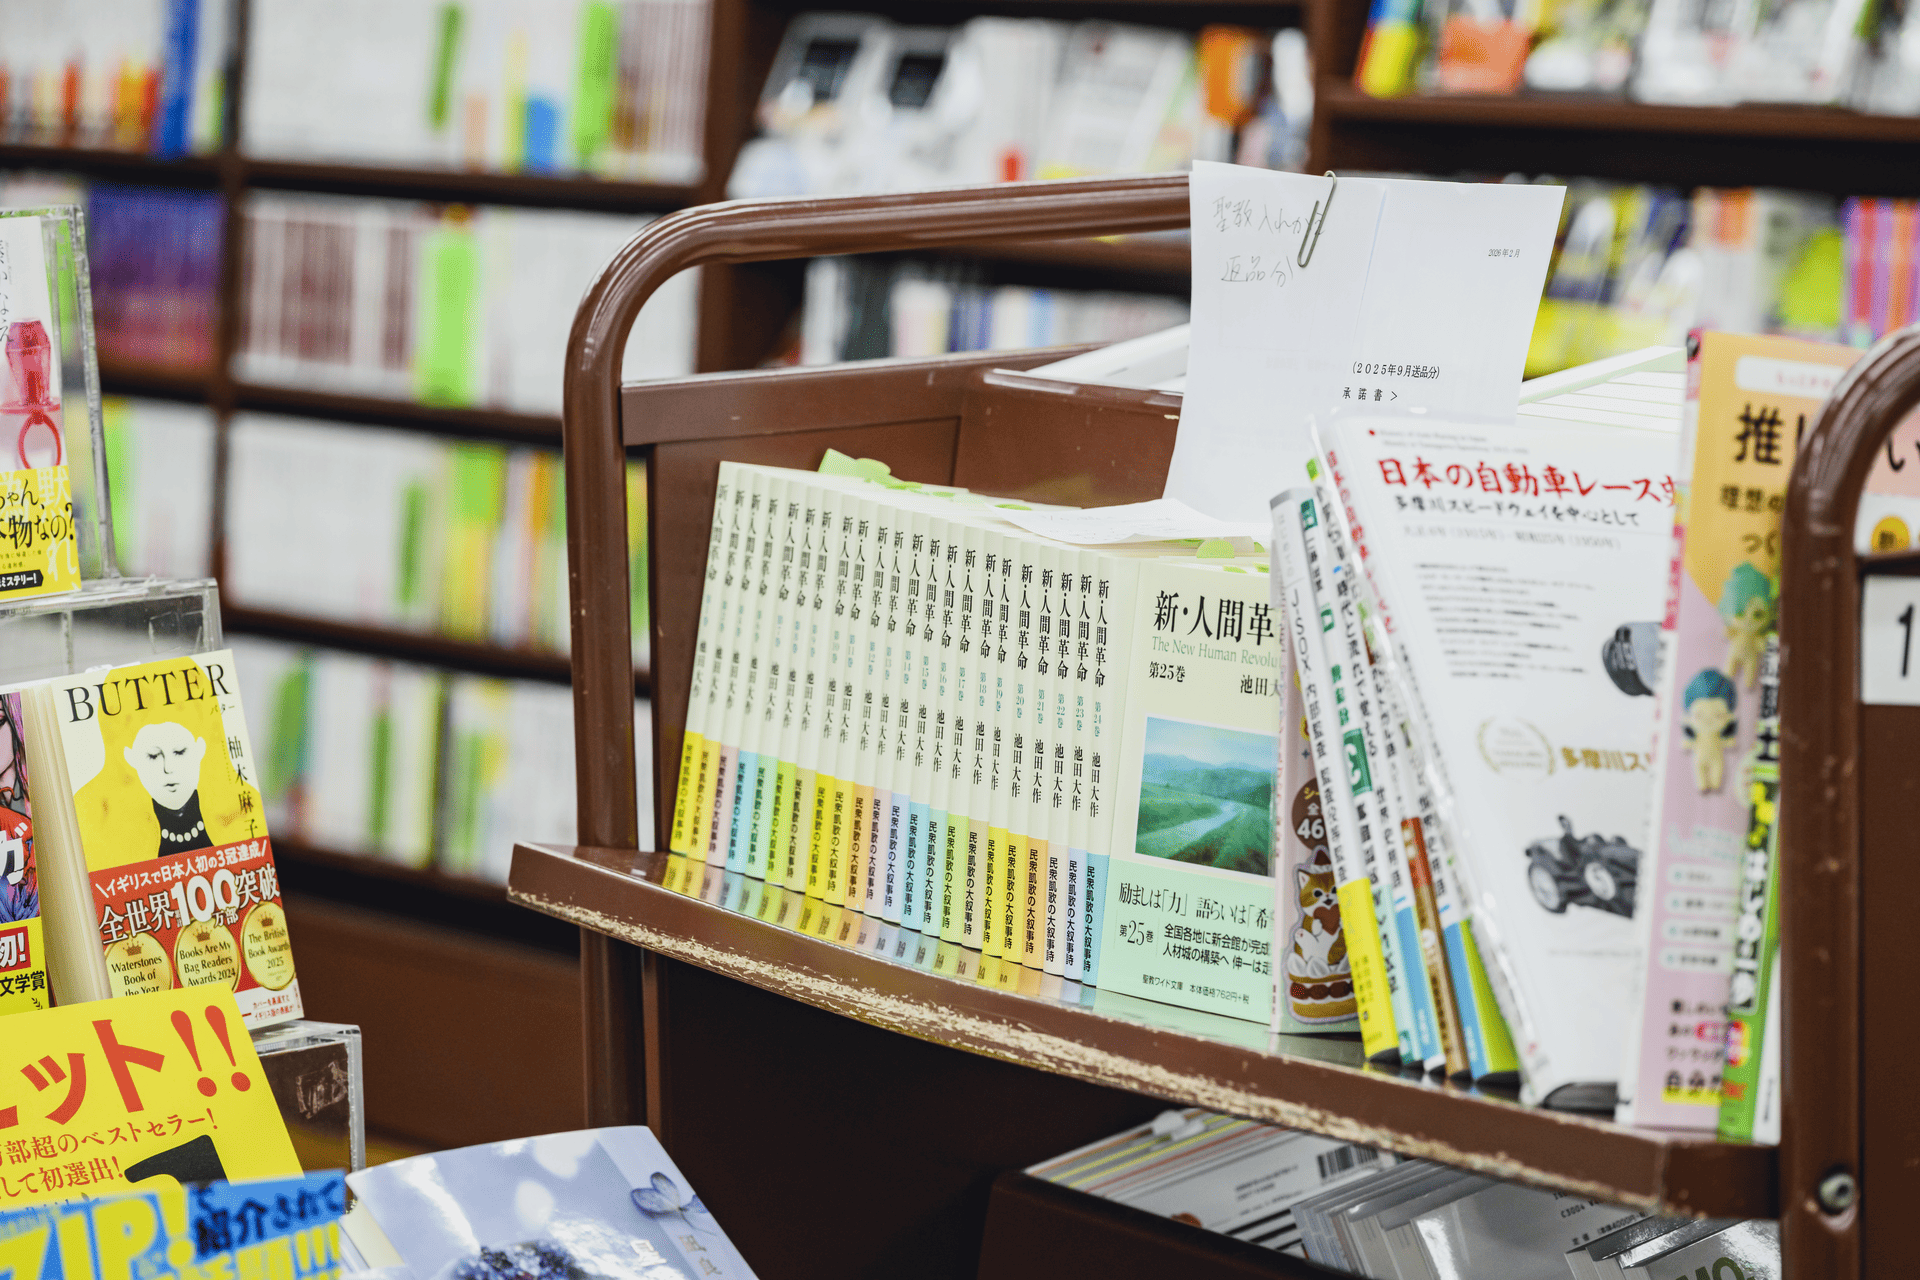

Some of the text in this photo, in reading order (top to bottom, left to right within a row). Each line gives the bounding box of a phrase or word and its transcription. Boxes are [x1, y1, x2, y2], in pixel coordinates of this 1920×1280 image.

[1488, 248, 1520, 258] 2026年2月
[1152, 636, 1169, 652] The
[1172, 639, 1195, 655] New
[1199, 643, 1236, 662] Human
[938, 661, 948, 697] 第16巻
[957, 666, 967, 702] 第17巻
[978, 671, 988, 708] 第18巻
[1149, 661, 1186, 683] 第25巻
[63, 662, 232, 723] BUTTER
[210, 703, 235, 716] バター
[823, 678, 837, 738] 池田大作
[995, 676, 1004, 713] 第19巻
[1015, 682, 1026, 720] 第20巻
[1036, 688, 1046, 725] 第21巻
[1055, 692, 1067, 730] 第22巻
[839, 682, 853, 743] 池田大作
[860, 690, 873, 751] 池田大作
[877, 693, 890, 755] 池田大作
[896, 698, 909, 761] 池田大作
[1074, 694, 1085, 732] 第23巻
[1092, 700, 1103, 738] 第24巻
[914, 704, 927, 767] 池田大作
[933, 709, 945, 773] 池田大作
[952, 716, 964, 779] 池田大作
[973, 721, 985, 785] 池田大作
[991, 726, 1001, 791] 池田大作
[1011, 733, 1023, 798] 池田大作
[1032, 739, 1044, 804] 池田大作
[1052, 743, 1065, 808] 池田大作
[227, 735, 258, 839] 柚木麻子
[1072, 746, 1084, 811] 池田大作
[1090, 752, 1101, 818] 池田大作
[1297, 818, 1325, 839] 46
[1118, 882, 1188, 916] 励ましは「力」
[179, 941, 231, 960] Books Are My
[248, 927, 286, 943] The British
[1119, 920, 1154, 946] 第25巻
[111, 955, 162, 974] Waterstones
[184, 956, 233, 974] Bag Readers
[248, 947, 266, 958] Book
[267, 956, 284, 969] 2025
[1163, 942, 1229, 966] 人材城の構築へ
[124, 969, 157, 986] Book of
[187, 968, 236, 988] Awards 2024
